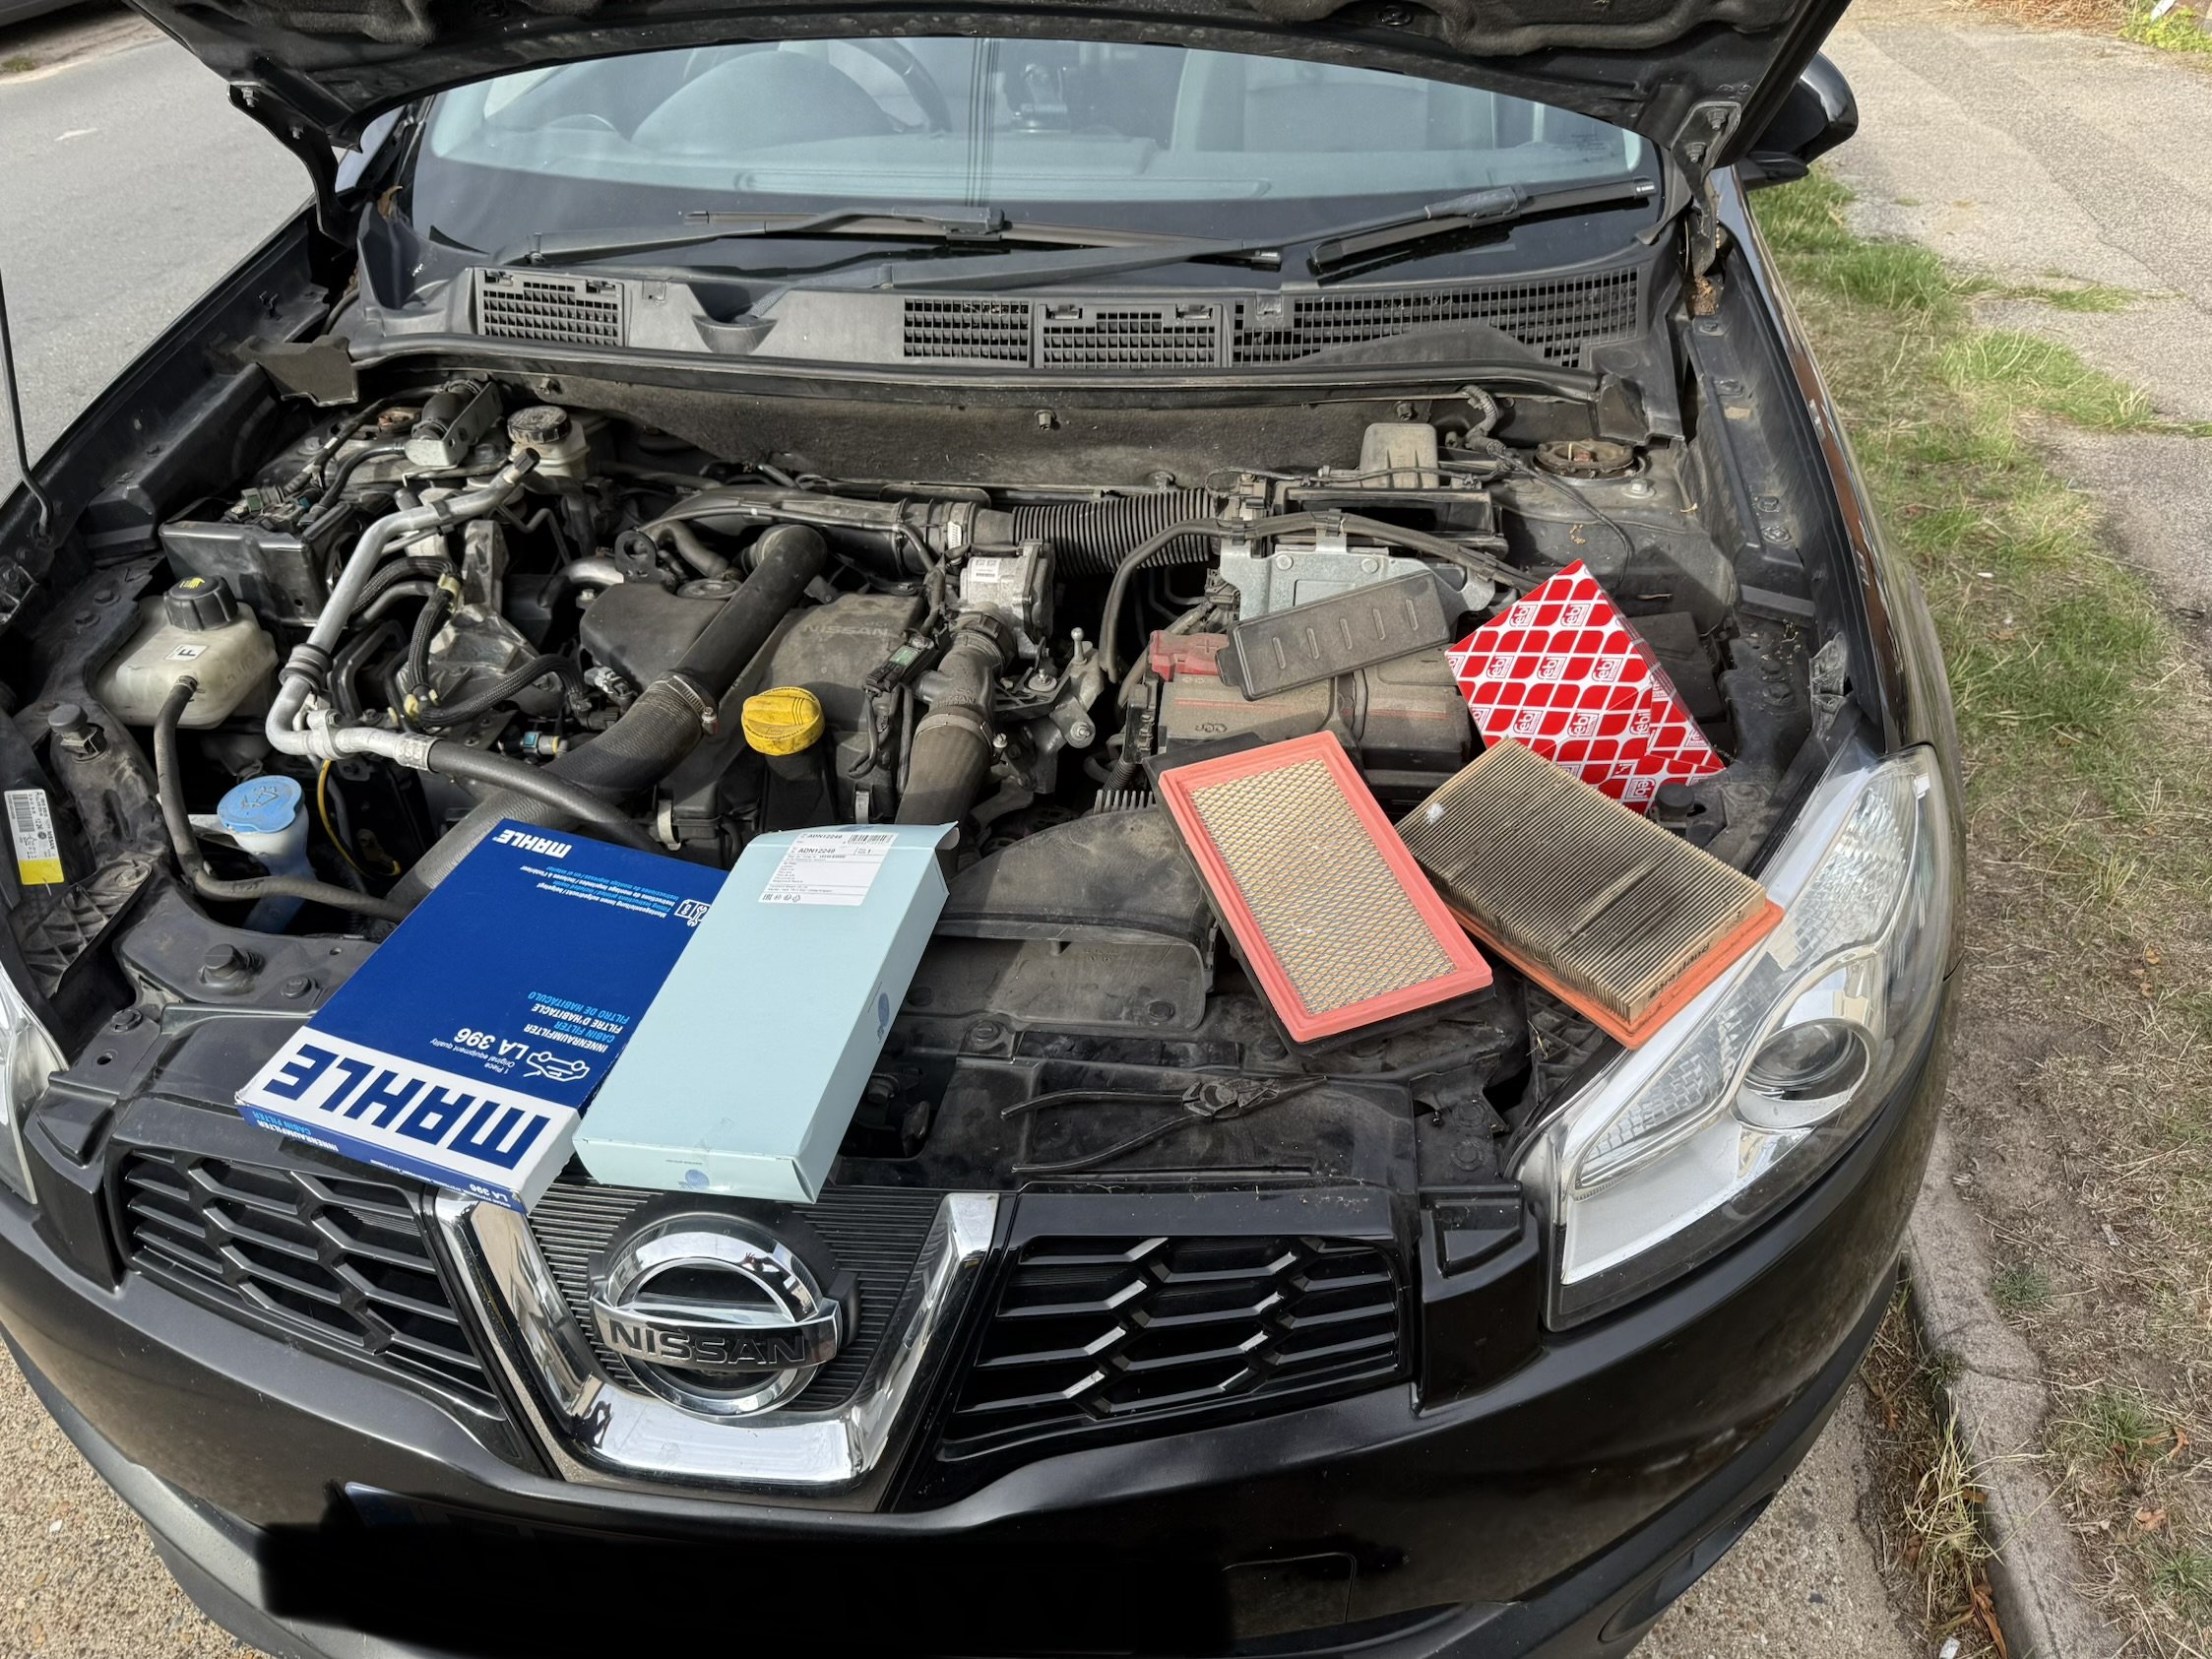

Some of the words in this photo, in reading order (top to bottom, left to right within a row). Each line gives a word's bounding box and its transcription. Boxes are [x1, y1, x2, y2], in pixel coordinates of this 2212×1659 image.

[1510, 604, 1532, 627] febi
[1560, 604, 1582, 627] febi
[803, 624, 888, 636] NISSAN
[1486, 656, 1510, 679] febi
[1537, 656, 1561, 679] febi
[1592, 657, 1616, 682] febi
[1513, 709, 1535, 734] febi
[1568, 710, 1591, 736] febi
[1629, 709, 1650, 735] febi
[1636, 777, 1656, 798] febi
[496, 829, 573, 859] MAHLE
[528, 991, 584, 1012] HABITÁCULO
[583, 1006, 598, 1016] DE
[532, 1003, 591, 1025] D'HABITACLE
[598, 1010, 630, 1024] FILTRO
[553, 1021, 586, 1035] FILTER
[585, 1029, 615, 1043] CABIN
[590, 1019, 623, 1034] FILTRE
[429, 1038, 453, 1049] quality
[454, 1028, 495, 1050] 396
[524, 1024, 607, 1052] INNENRAUMFILTER
[453, 1046, 488, 1059] equipment
[498, 1039, 529, 1059] LA
[483, 1062, 504, 1073] Piece
[487, 1055, 515, 1068] Original
[262, 1044, 550, 1170] MAHLE
[252, 1111, 283, 1126] FILTER
[284, 1120, 311, 1135] CABIN
[257, 1119, 338, 1151] INNENRAUMFILTER
[491, 1190, 508, 1202] LA
[608, 1318, 805, 1365] NISSAN
